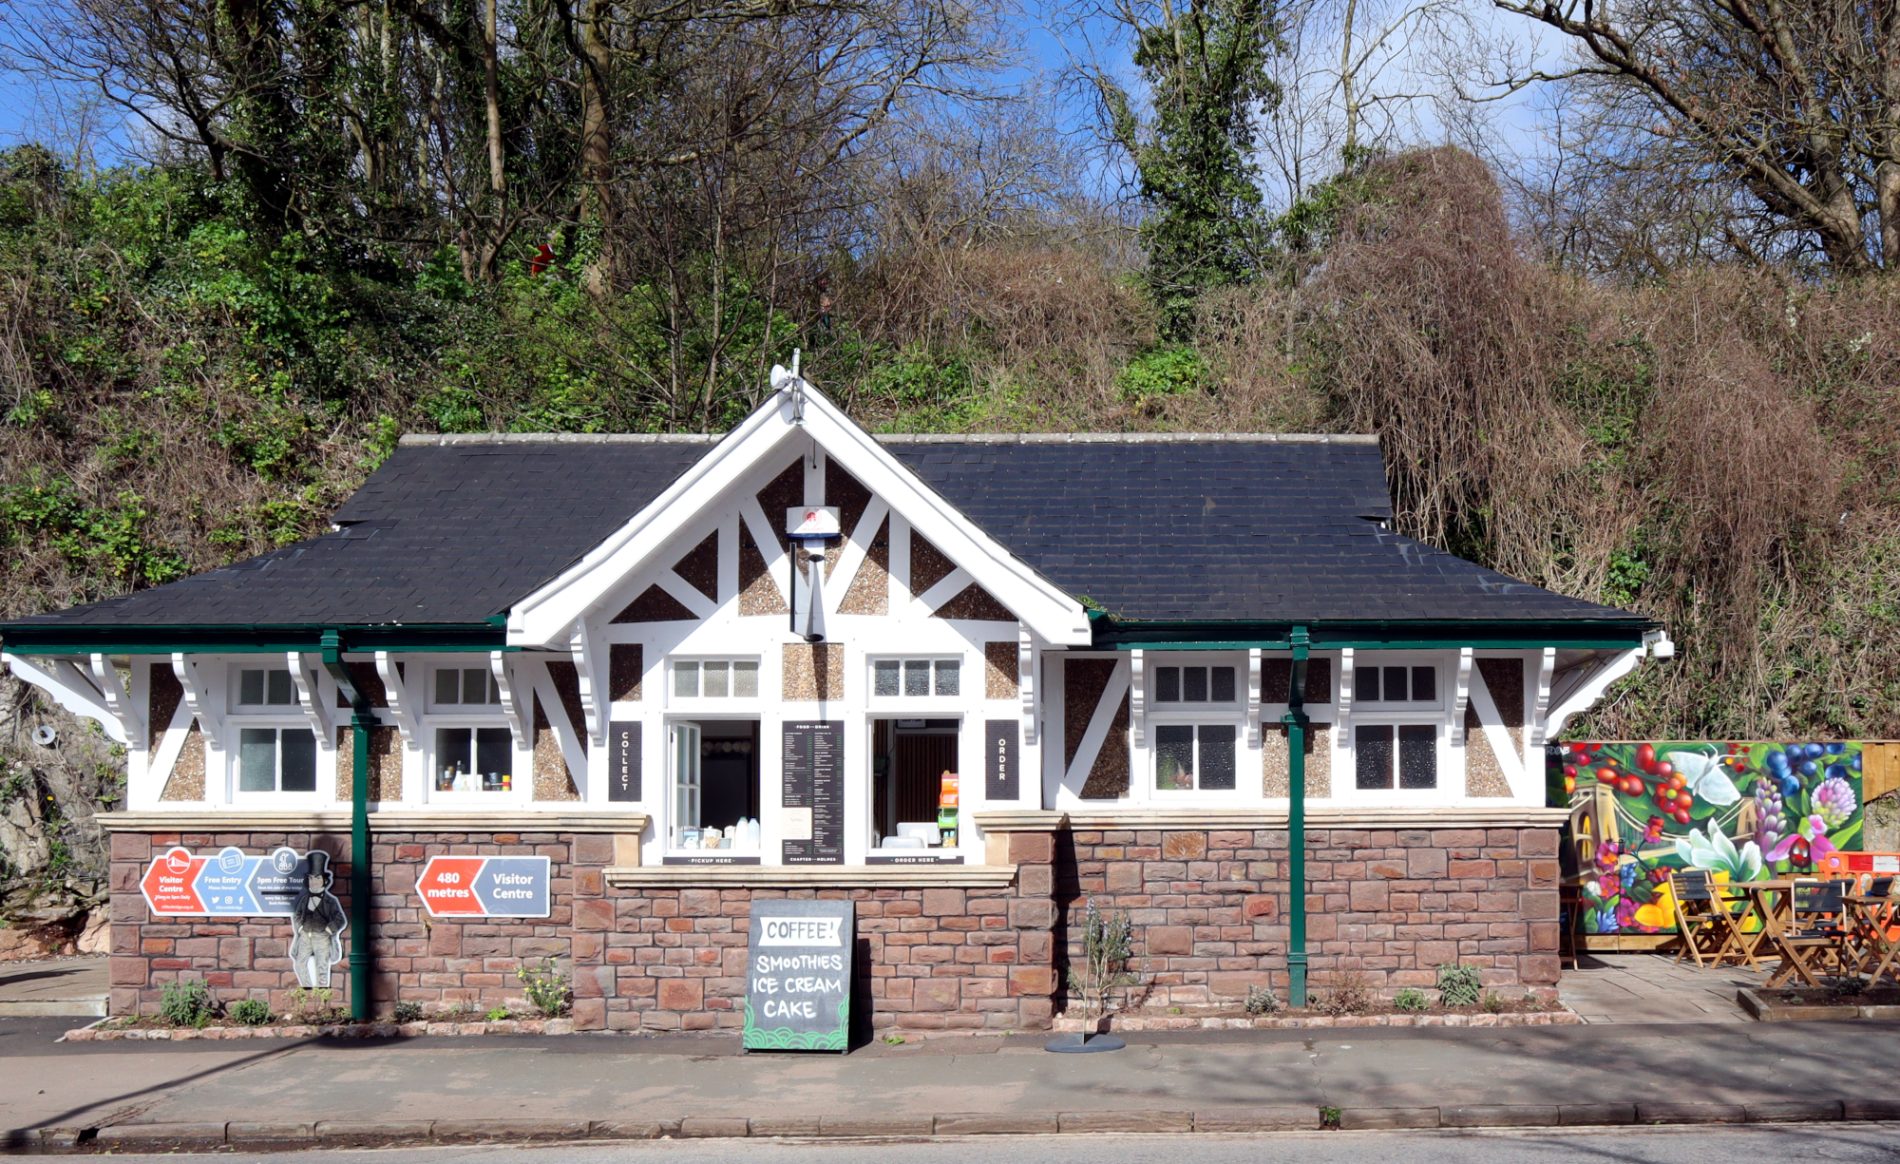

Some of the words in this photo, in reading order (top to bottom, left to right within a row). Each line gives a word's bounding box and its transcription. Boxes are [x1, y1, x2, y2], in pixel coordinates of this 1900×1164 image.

[621, 731, 629, 791] COLLECT
[998, 738, 1006, 781] ORDER
[222, 877, 242, 886] Entry
[437, 872, 460, 884] 480
[492, 873, 534, 885] Visitor
[427, 888, 470, 898] metres
[492, 887, 534, 899] Centre
[767, 922, 834, 939] COFFEE!
[756, 954, 843, 974] SMOOTHIES
[752, 977, 779, 995] ICE
[784, 976, 842, 994] CREAM
[763, 999, 817, 1019] CAKE
